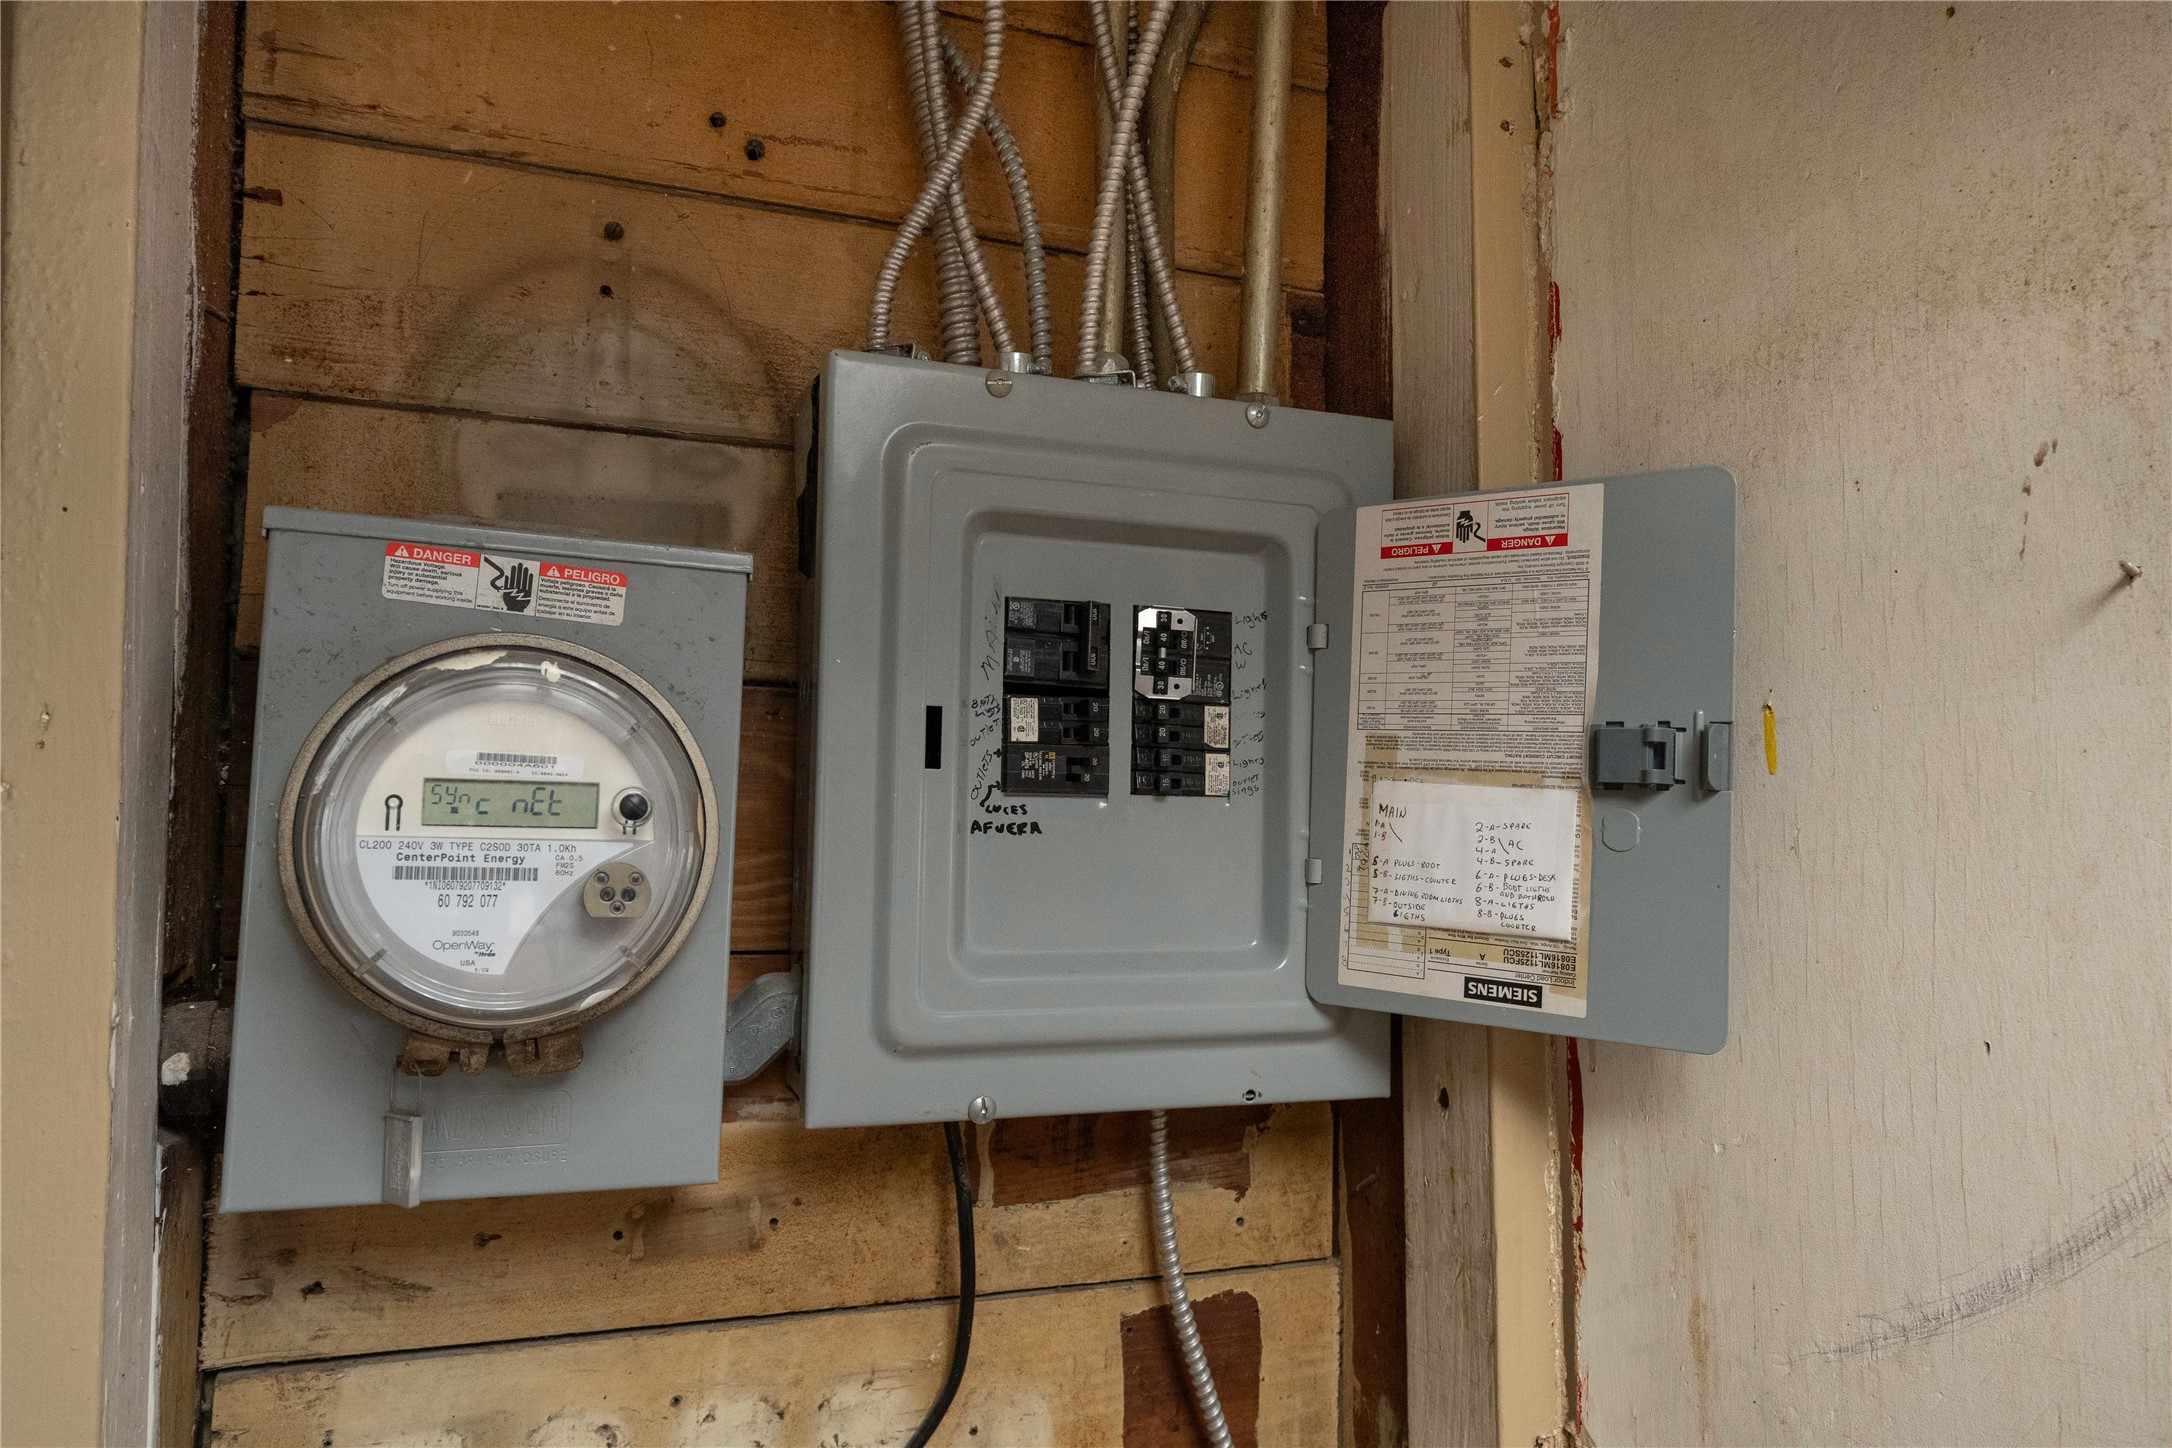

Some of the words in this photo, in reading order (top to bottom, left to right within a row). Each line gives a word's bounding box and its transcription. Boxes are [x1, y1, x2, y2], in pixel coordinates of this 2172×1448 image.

[1501, 538, 1541, 548] DANGER
[1392, 546, 1429, 556] PELIGRO
[413, 548, 472, 565] DANGER
[390, 558, 422, 567] Hazardous
[415, 572, 448, 580] substantial
[421, 567, 439, 575] death,
[388, 575, 413, 583] property
[415, 578, 440, 586] damage.
[564, 569, 620, 585] PELIGRO
[540, 577, 559, 587] Voltaje
[560, 579, 586, 588] peligroso.
[588, 583, 610, 591] Causará
[562, 585, 584, 593] lesiones
[387, 589, 415, 597] equipment
[416, 591, 433, 599] before
[434, 594, 456, 602] working
[427, 587, 452, 596] supplying
[539, 589, 571, 597] substancial
[583, 594, 611, 602] propiedad.
[1160, 613, 1168, 622] 30
[1160, 632, 1168, 642] 40
[1234, 642, 1253, 656] AC
[1158, 660, 1166, 670] 40
[1157, 681, 1165, 690] 30
[1092, 702, 1098, 712] 20
[1159, 704, 1166, 715] 20
[1093, 727, 1100, 737] 20
[1159, 727, 1166, 737] 20
[1092, 757, 1098, 766] 20
[1162, 755, 1170, 764] 15
[1084, 773, 1091, 782] 20
[1163, 778, 1170, 787] 15
[985, 804, 1028, 816] LUCES
[1379, 803, 1407, 819] MAIN
[970, 820, 1042, 836] AFUERA
[359, 840, 392, 850] CL200
[398, 841, 424, 850] 240V
[430, 842, 444, 850] 3W
[450, 842, 474, 851] TYPE
[517, 844, 541, 852] 30TA
[548, 844, 577, 853] 1.0Kh
[1508, 839, 1524, 851] AC
[396, 852, 476, 863] CenterPoint
[483, 854, 526, 866] Energy
[1346, 863, 1351, 873] 2
[1500, 891, 1515, 899] AND
[438, 894, 450, 908] 60
[456, 894, 474, 908] 792
[480, 894, 498, 908] 077
[1344, 906, 1349, 917] 5
[432, 940, 493, 952] OpenWay
[1434, 948, 1451, 957] Type
[1480, 953, 1486, 961] A
[1503, 948, 1576, 964] E0816ML1125SCU
[1342, 955, 1347, 966] 8
[1503, 957, 1576, 972] E0816ML1125FCU
[1514, 972, 1536, 982] Center
[1537, 975, 1553, 983] Load
[1554, 976, 1575, 986] Indoor
[1468, 982, 1538, 1002] SIEMENS
